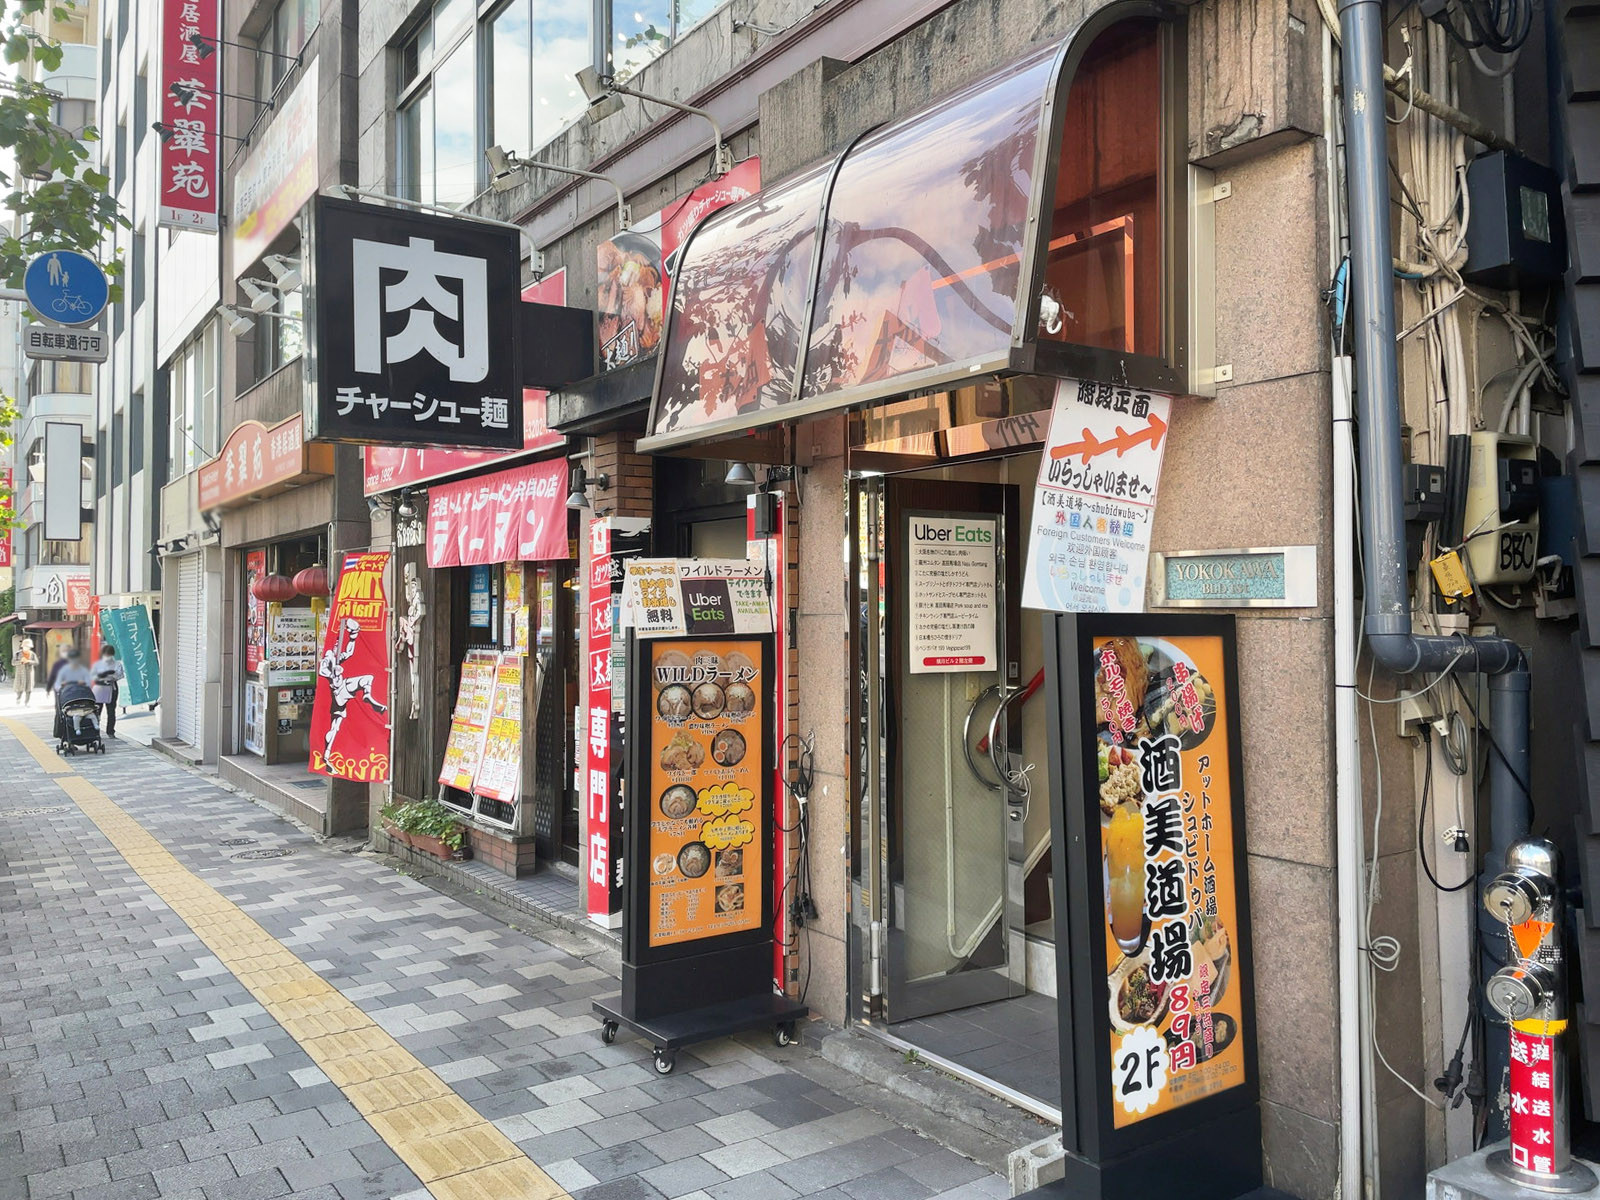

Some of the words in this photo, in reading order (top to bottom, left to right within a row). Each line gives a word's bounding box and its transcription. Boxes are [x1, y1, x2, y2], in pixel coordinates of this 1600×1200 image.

[179, 0, 201, 65] 居酒屋
[352, 237, 489, 383] 肉
[31, 331, 101, 352] 自転車通行可
[335, 387, 509, 429] チャーシュー麺
[1077, 379, 1151, 418] 階段正面
[914, 524, 952, 541] Uber
[955, 526, 992, 543] Eats
[1037, 525, 1068, 540] Foreign
[1070, 531, 1110, 546] Customers
[1112, 537, 1145, 552] Welcome
[1500, 531, 1534, 571] BBC
[681, 565, 763, 577] ワイルドラーメン
[1070, 582, 1106, 595] Welcome
[1176, 560, 1279, 581] YOKOKAWA
[646, 608, 674, 623] 無料
[689, 593, 722, 606] Uber
[692, 608, 725, 621] Eats
[737, 590, 763, 599] できます
[127, 622, 150, 699] コインランドリー
[656, 666, 759, 683] WILDラーメン
[1100, 650, 1135, 732] ホルモン焼き
[1173, 661, 1205, 734] 串揚げ
[1101, 697, 1123, 744] 500円
[589, 706, 608, 887] 専門店
[1198, 755, 1218, 916] アットホーム酒場
[1139, 735, 1192, 984] 酒美道場
[1182, 792, 1204, 930] シュビドゥバ
[1169, 984, 1197, 1074] 89円
[1120, 1045, 1160, 1096] 2F
[1510, 1039, 1529, 1169] 送水口
[1531, 1043, 1552, 1174] 連結送水管
